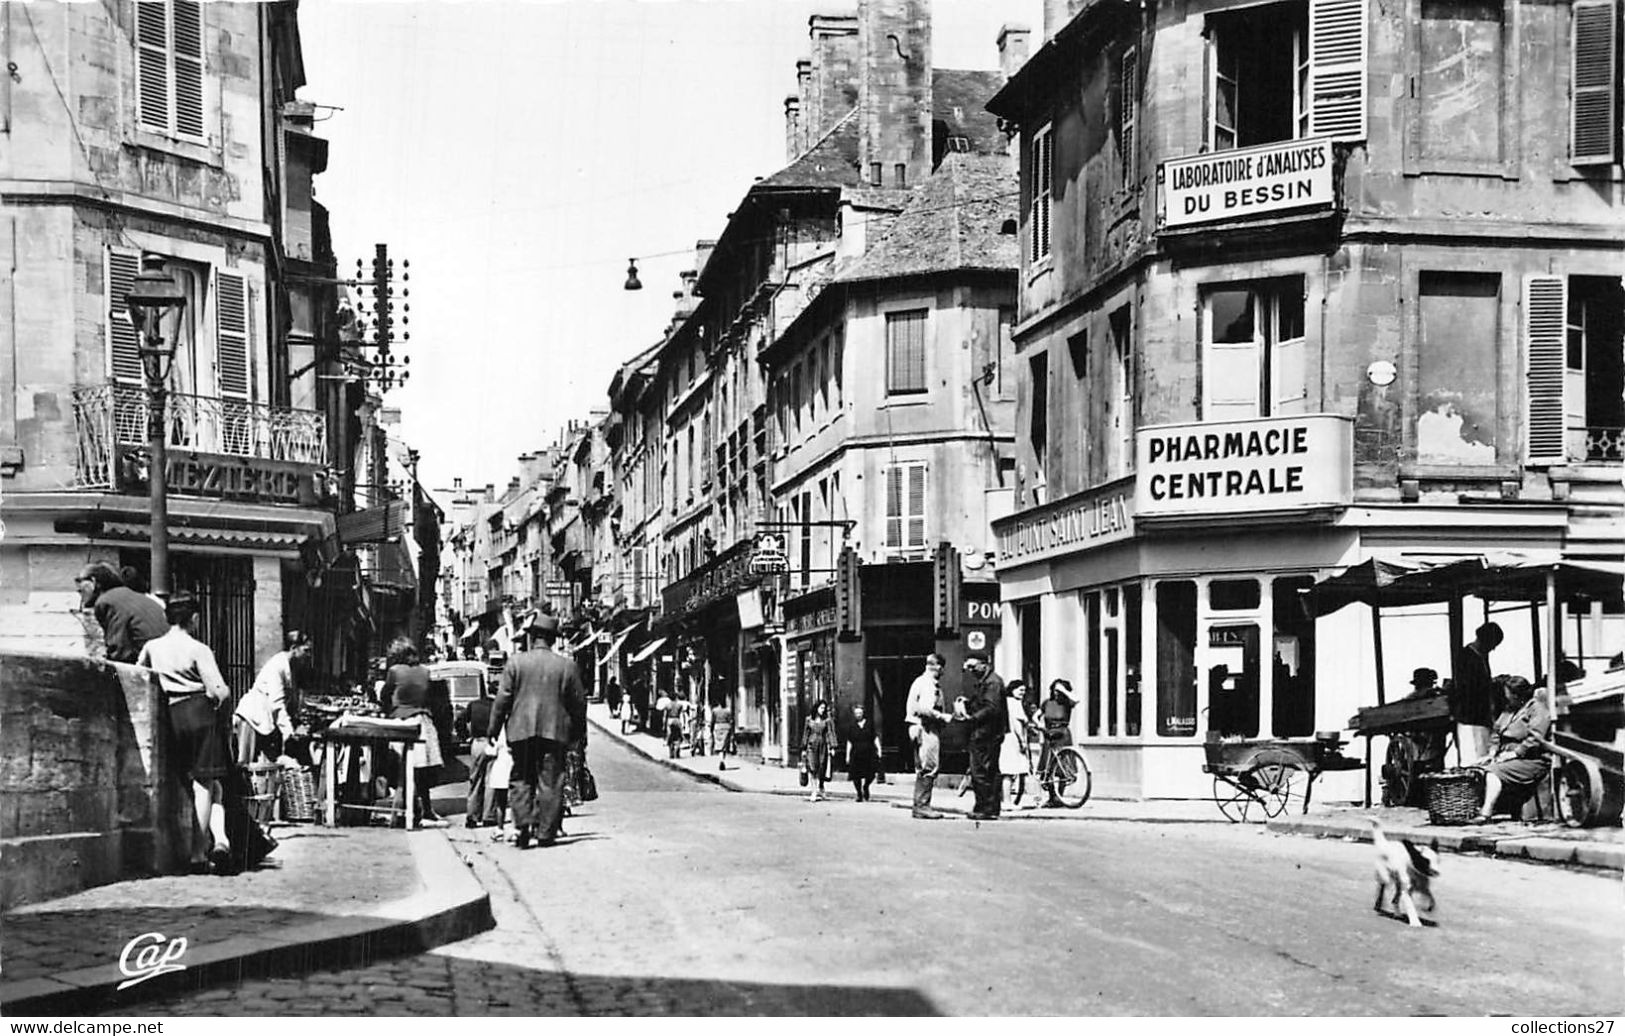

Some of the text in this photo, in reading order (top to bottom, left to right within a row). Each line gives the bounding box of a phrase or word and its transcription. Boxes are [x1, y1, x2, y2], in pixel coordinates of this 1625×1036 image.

[1173, 146, 1325, 190] LABORATOIRE d'ANALYSES
[1184, 179, 1312, 215] DU BESSIN
[1149, 427, 1308, 463] PHARMACIE
[1150, 466, 1303, 500] CENTRALE
[1017, 519, 1046, 556] PONT
[1050, 507, 1087, 548] SAINT
[1089, 494, 1127, 538] JEAN
